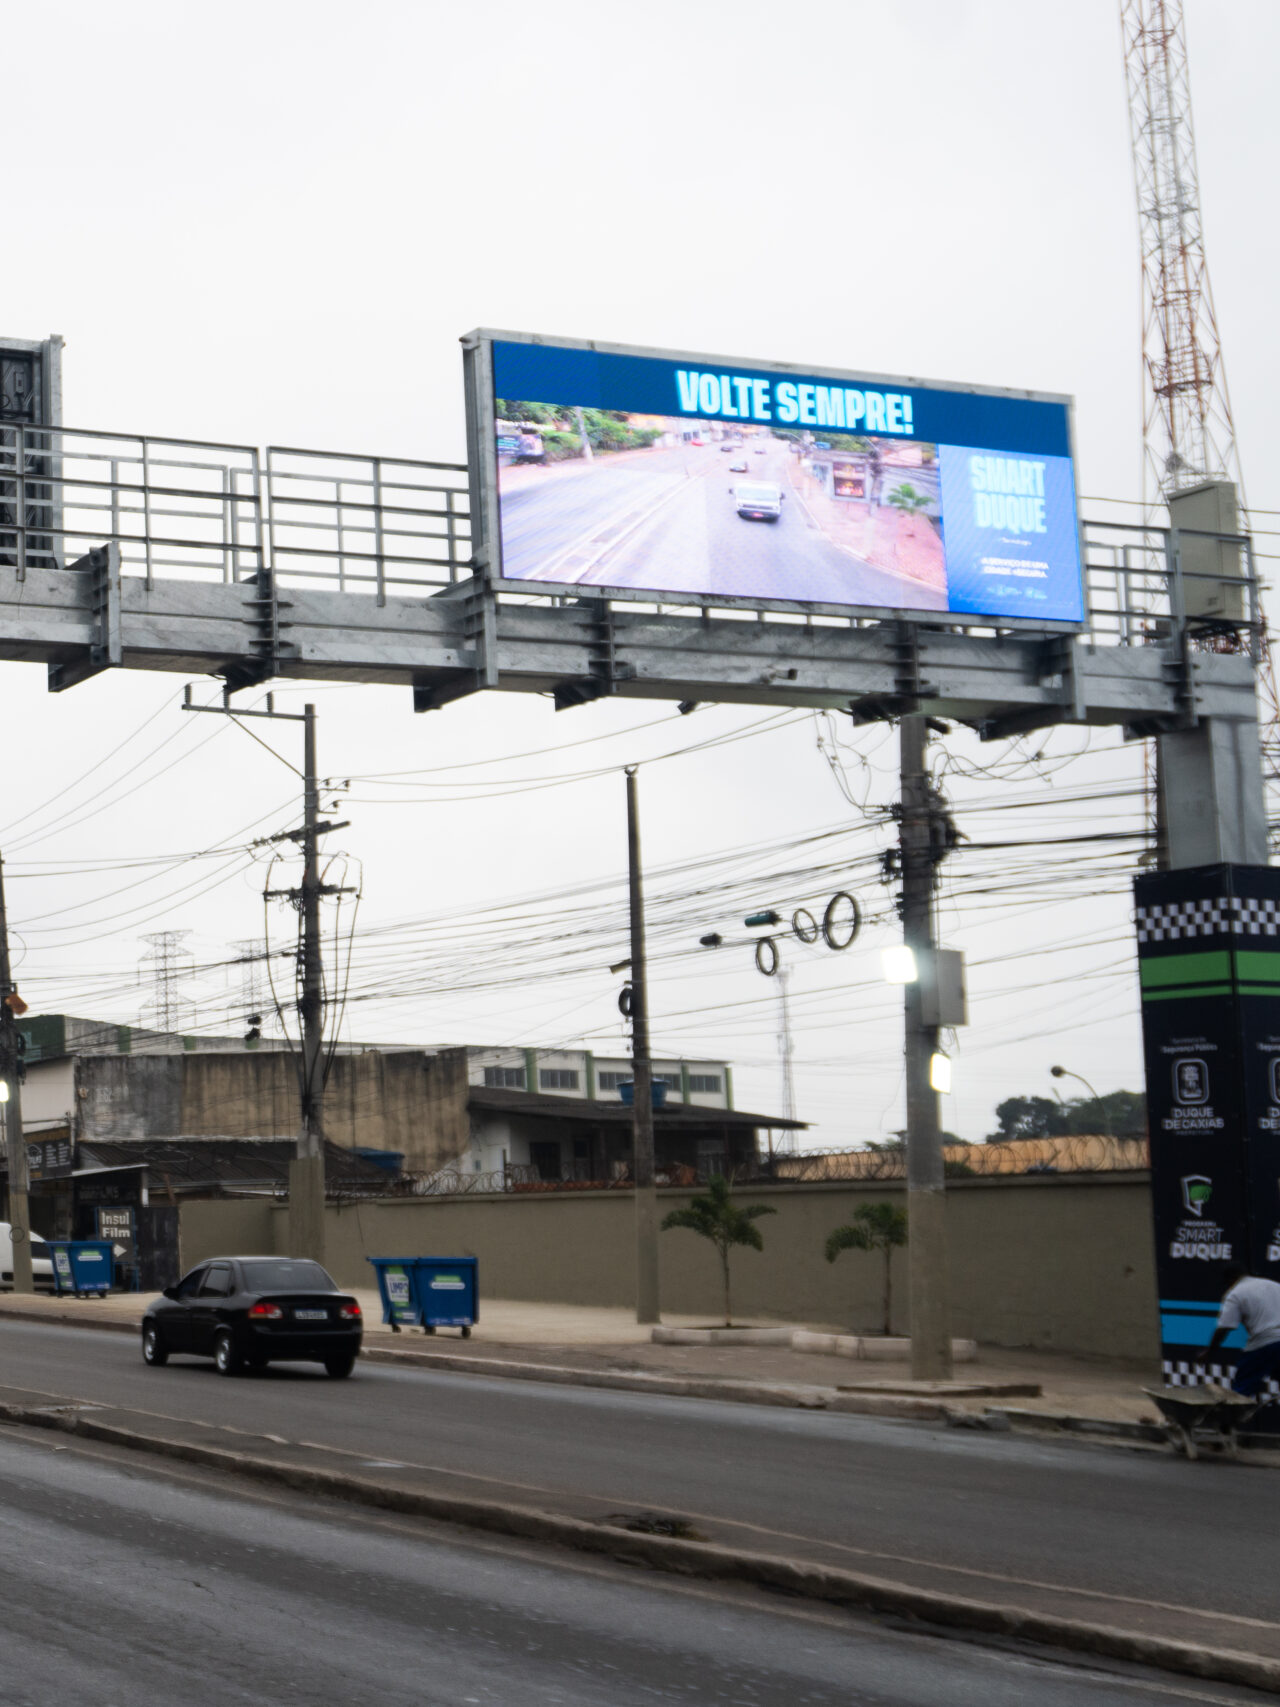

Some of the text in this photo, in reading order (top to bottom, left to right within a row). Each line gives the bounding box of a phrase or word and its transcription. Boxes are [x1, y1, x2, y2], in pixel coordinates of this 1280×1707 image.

[675, 369, 914, 434] VOLTE SEMPRE!
[970, 455, 1046, 497] SMART
[974, 492, 1048, 534] DUQUE
[1173, 1107, 1214, 1118] DUQUE
[1163, 1117, 1224, 1130] DE CAXIAS
[101, 1211, 130, 1225] Insul
[102, 1227, 131, 1238] Film
[1177, 1227, 1224, 1242] SMART
[1170, 1241, 1232, 1262] DUQUE
